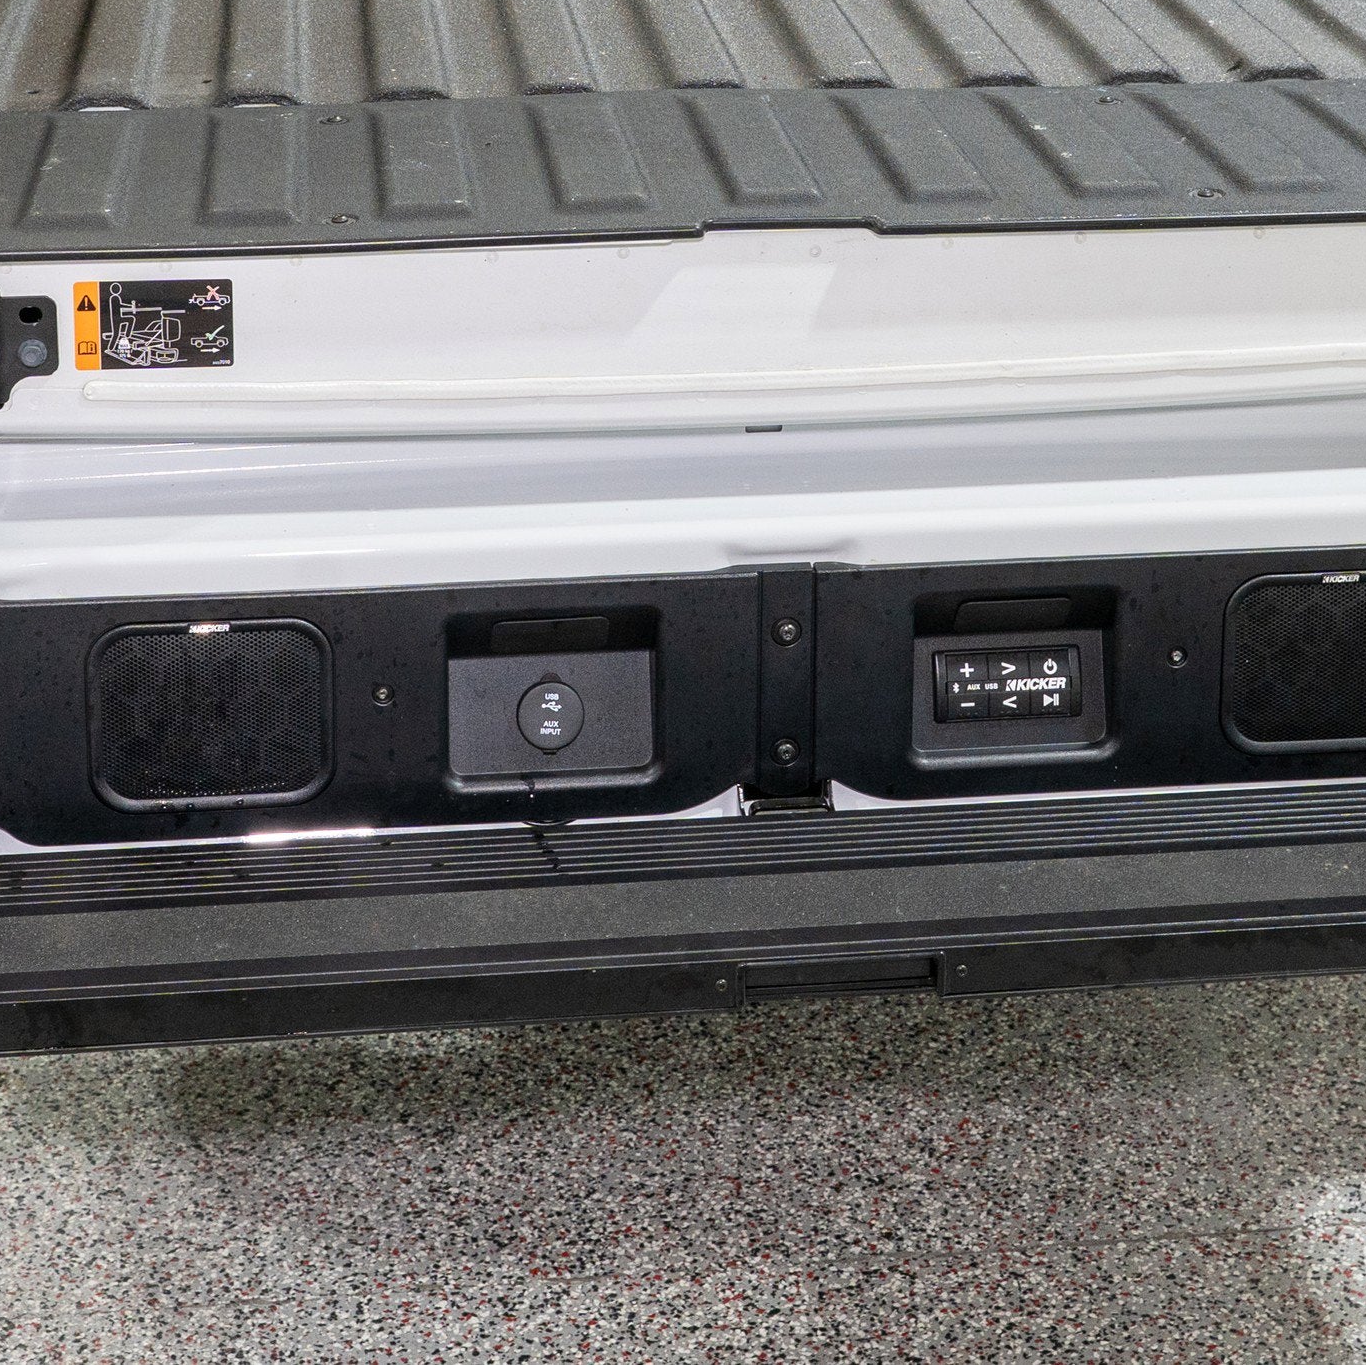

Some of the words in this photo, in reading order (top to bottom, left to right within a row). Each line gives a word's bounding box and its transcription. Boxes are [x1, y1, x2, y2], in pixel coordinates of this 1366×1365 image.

[1329, 575, 1360, 583] KICKER
[967, 683, 981, 691] AUX
[1016, 677, 1067, 691] KICKER
